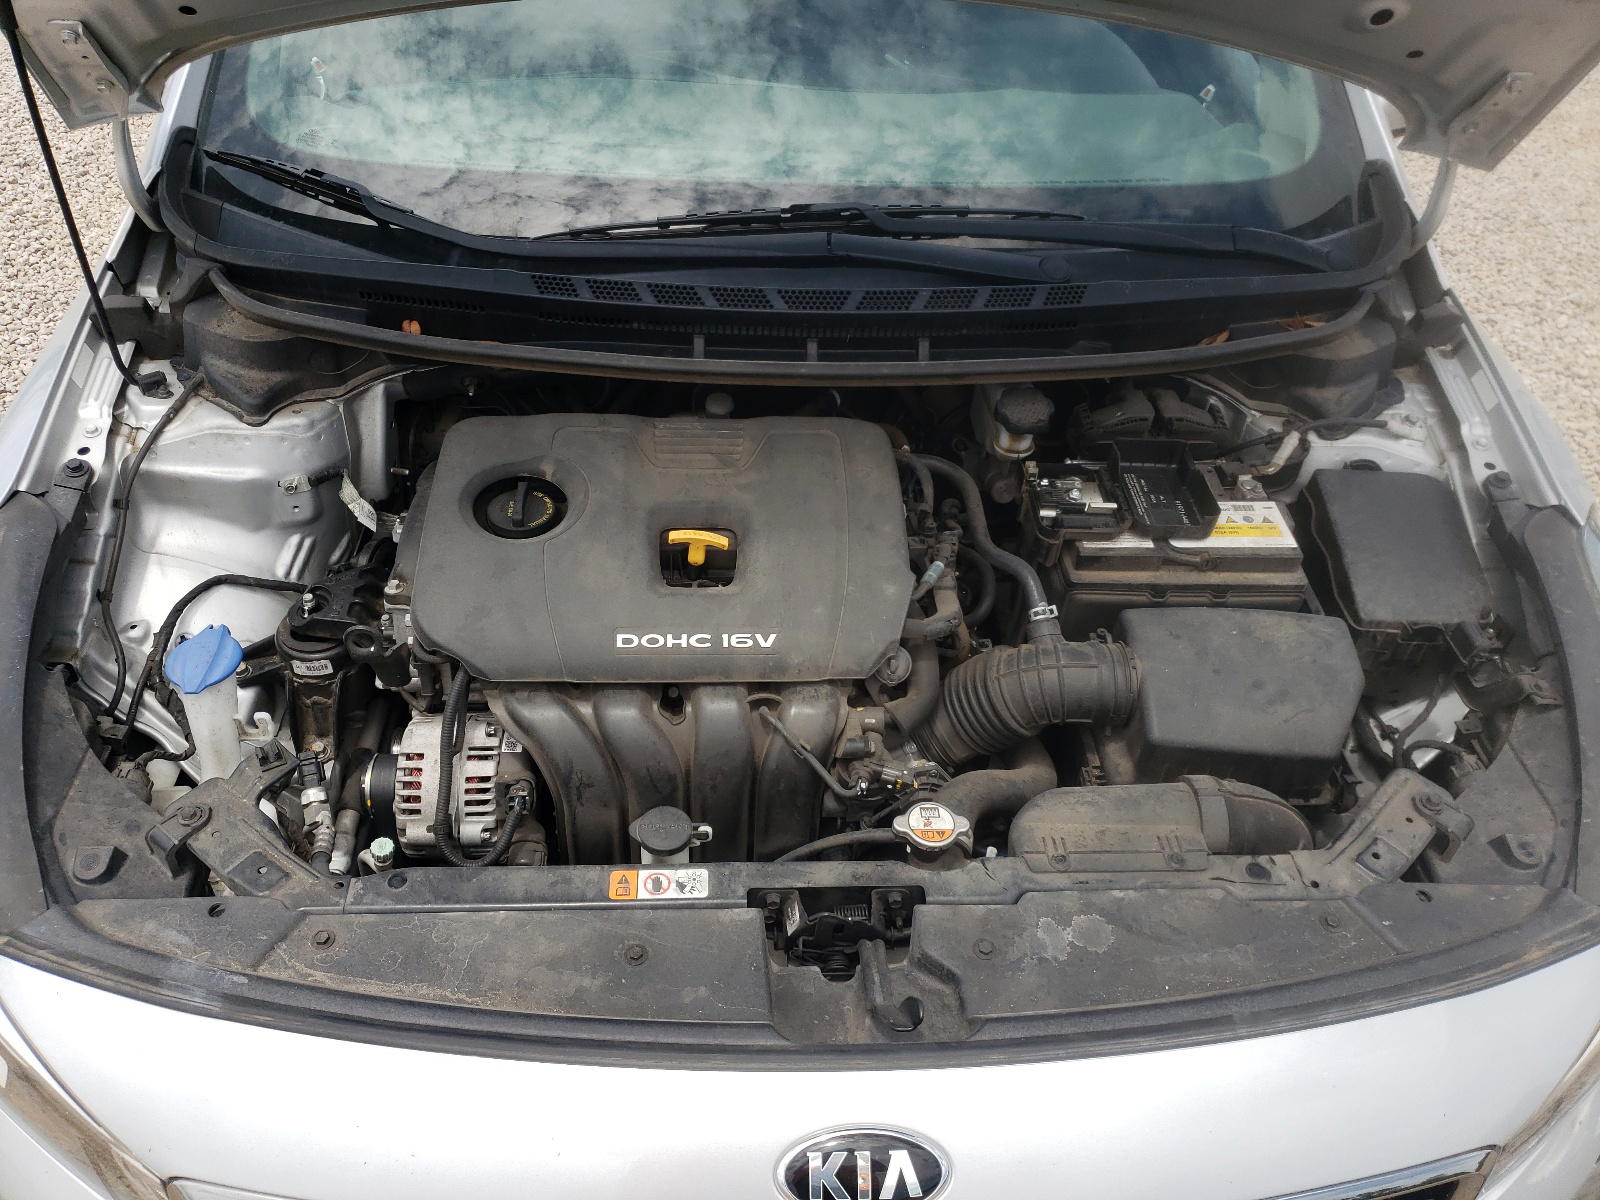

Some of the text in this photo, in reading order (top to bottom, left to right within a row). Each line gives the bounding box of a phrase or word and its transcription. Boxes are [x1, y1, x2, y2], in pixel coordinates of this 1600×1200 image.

[616, 633, 777, 648] DOHC 16V
[806, 1149, 923, 1200] KIA
